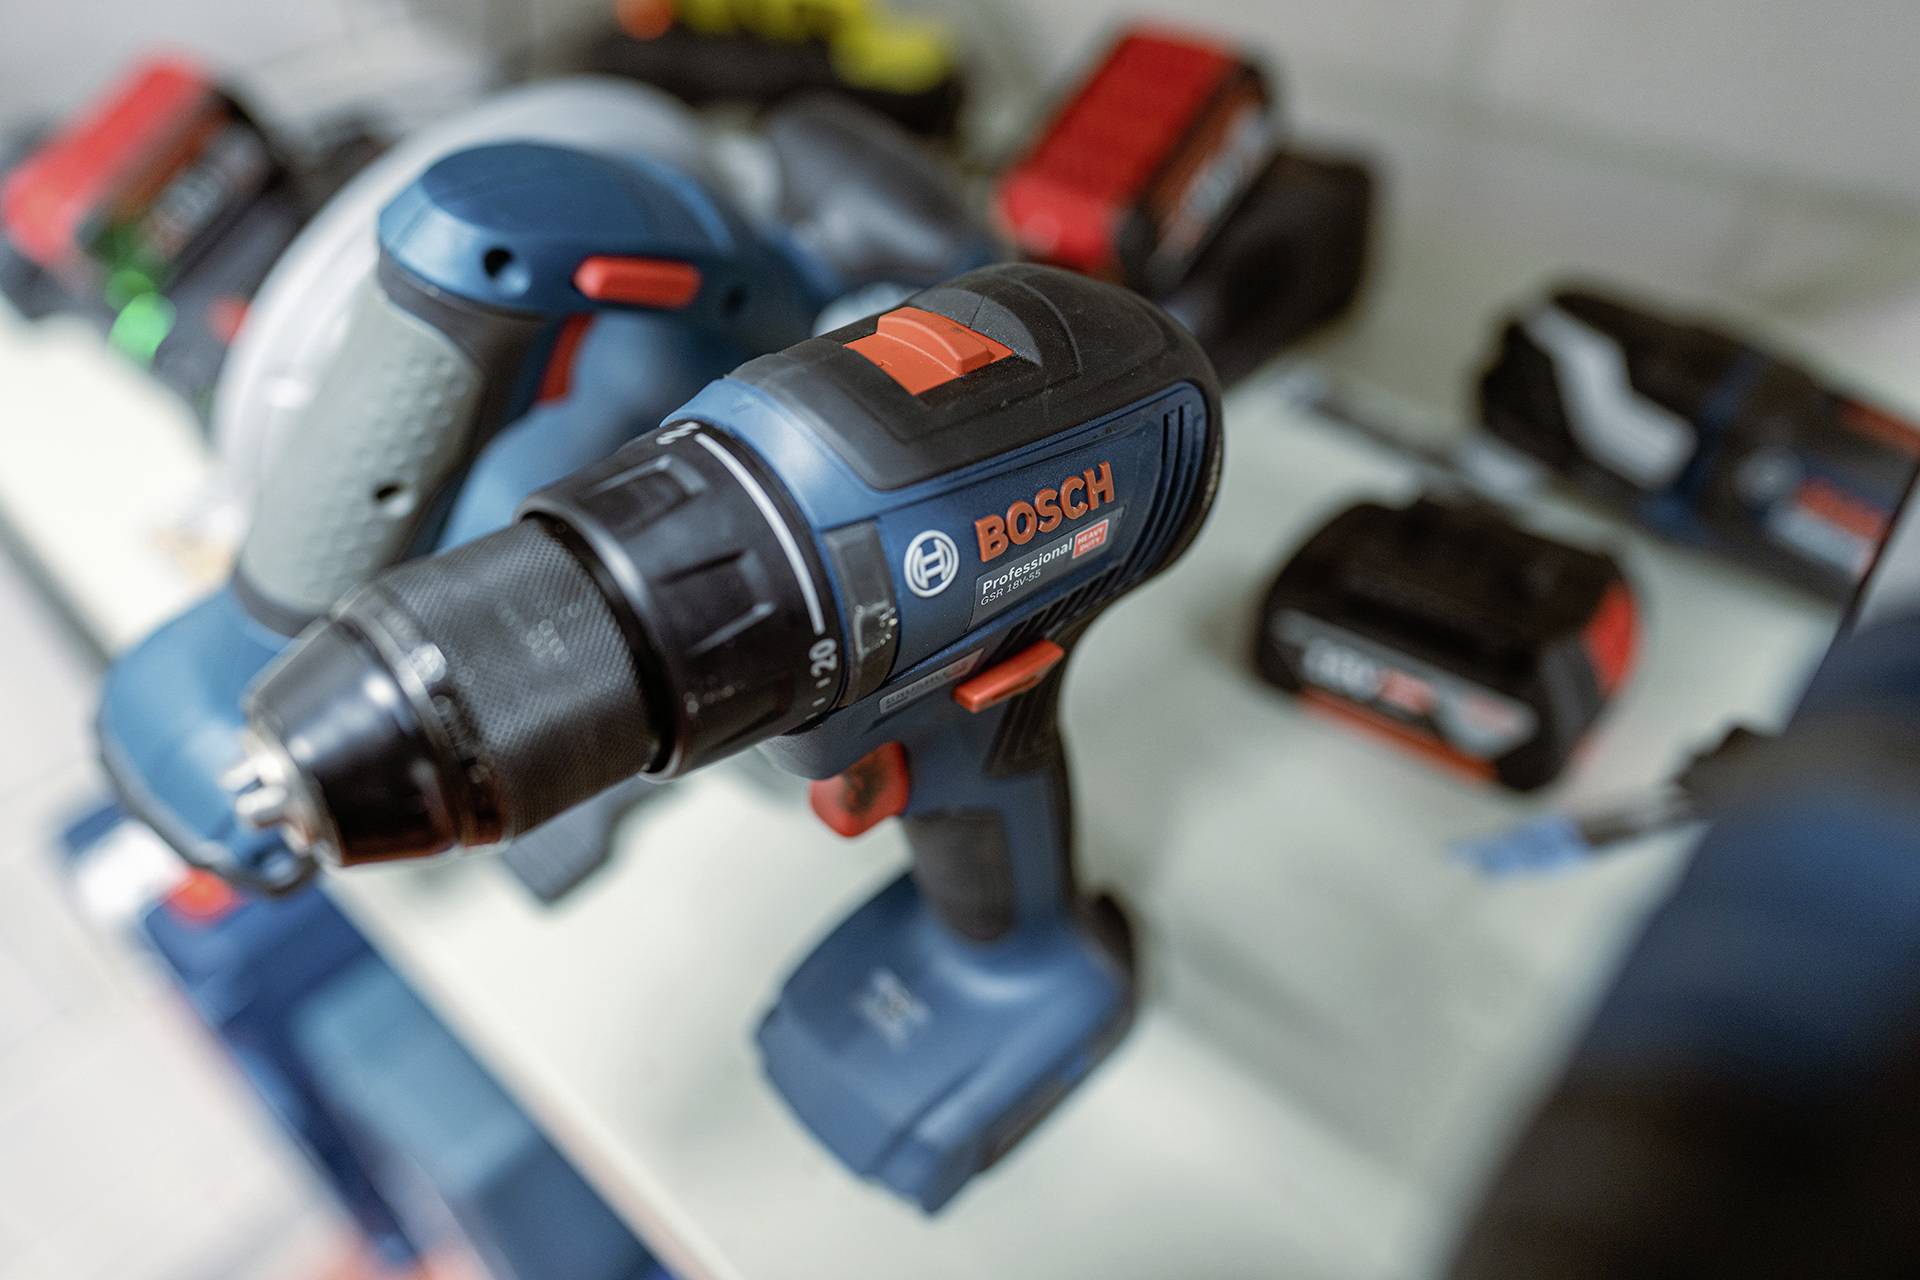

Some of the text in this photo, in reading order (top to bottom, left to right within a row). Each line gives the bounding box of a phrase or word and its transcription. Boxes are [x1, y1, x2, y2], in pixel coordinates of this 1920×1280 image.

[975, 460, 1115, 563] BOSCH
[980, 568, 1042, 606] GSR 18V-55
[982, 537, 1073, 595] Professional
[808, 638, 838, 678] 20
